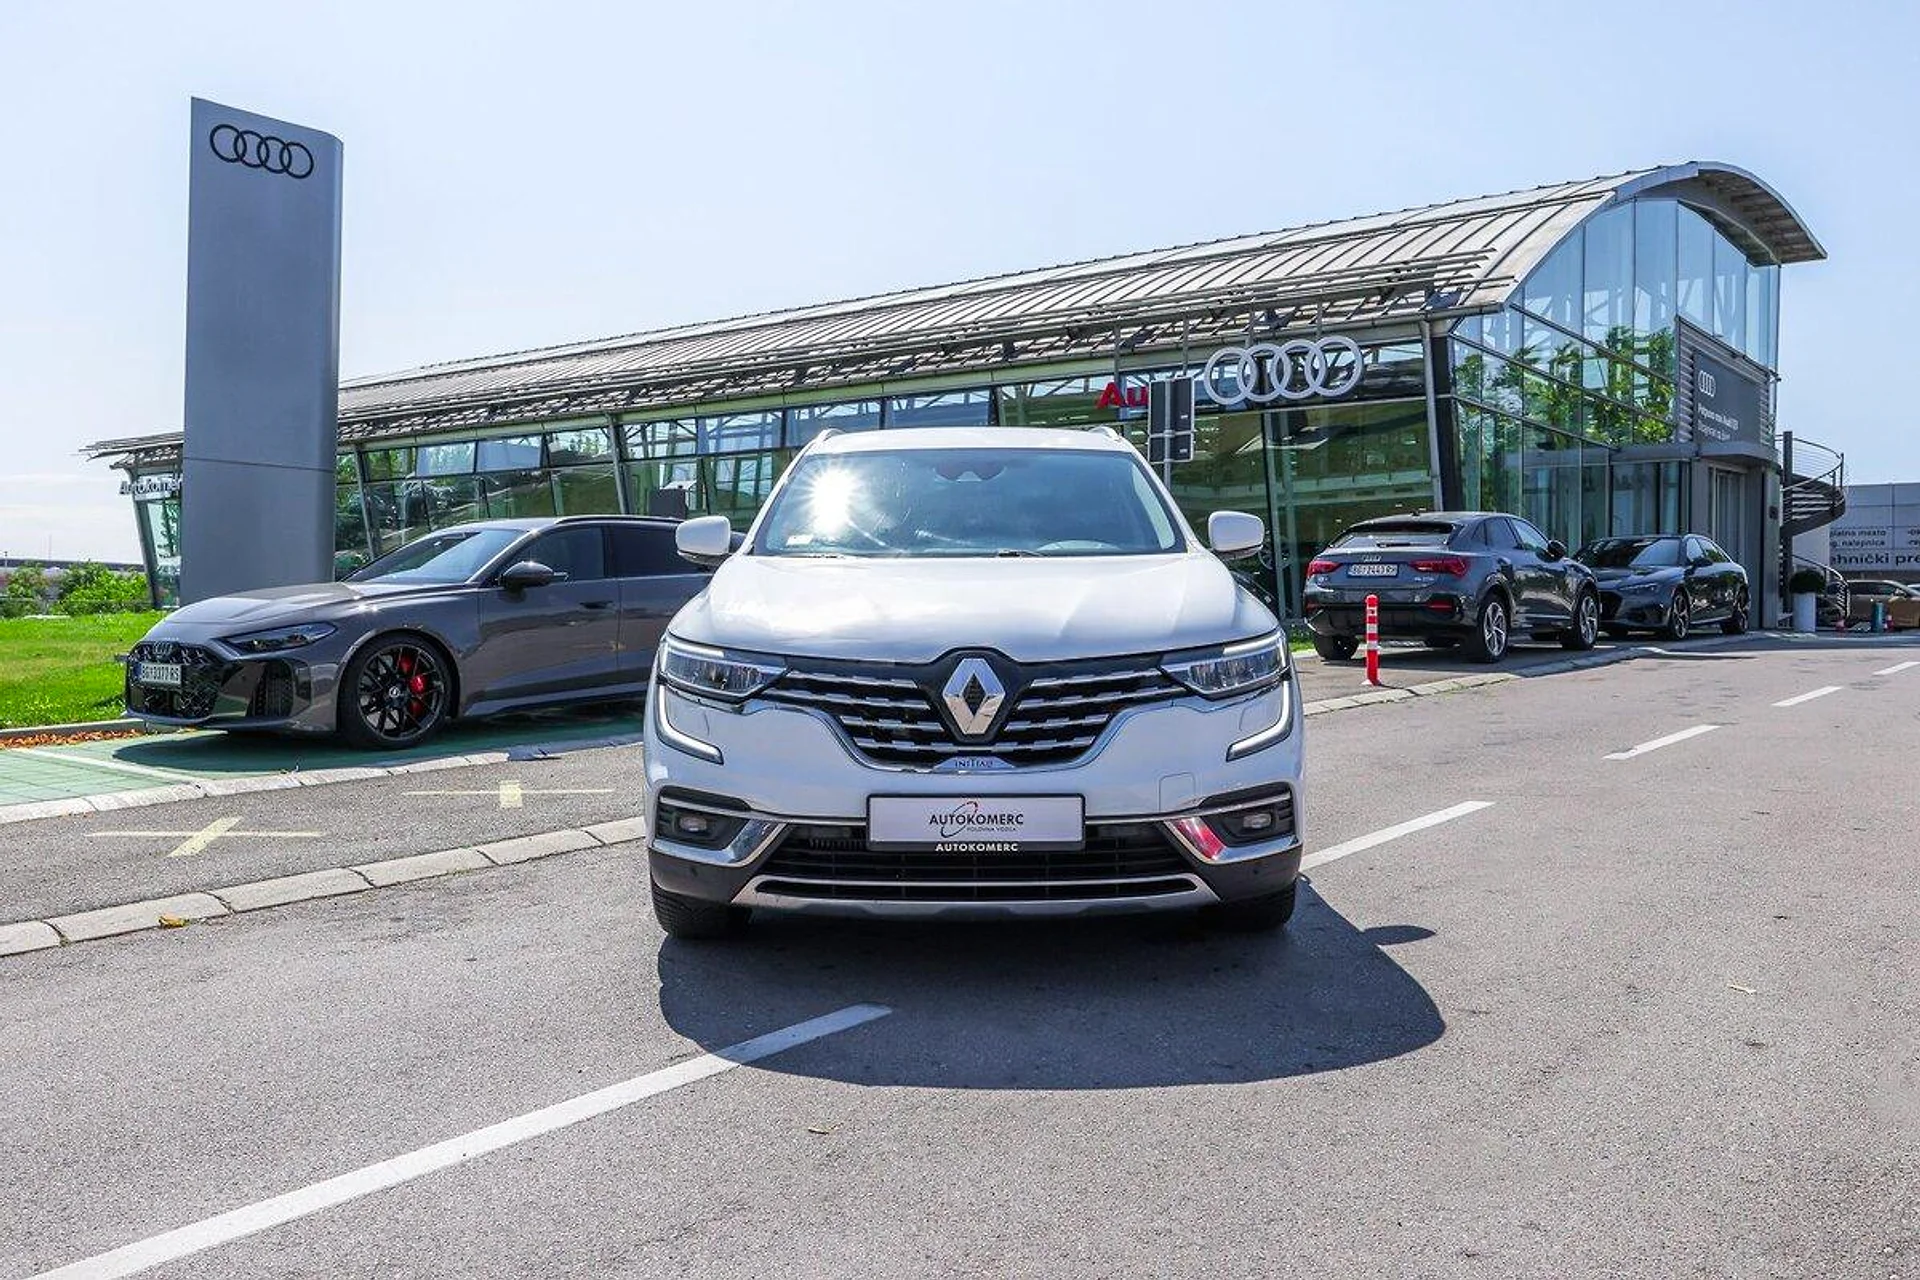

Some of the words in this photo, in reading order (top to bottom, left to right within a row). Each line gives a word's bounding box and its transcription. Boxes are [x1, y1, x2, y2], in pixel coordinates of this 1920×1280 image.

[1095, 382, 1149, 409] Au
[119, 473, 184, 495] Autokomer
[929, 813, 1024, 825] AUTOKOMERC
[935, 843, 1019, 852] AUTOKOMERC
